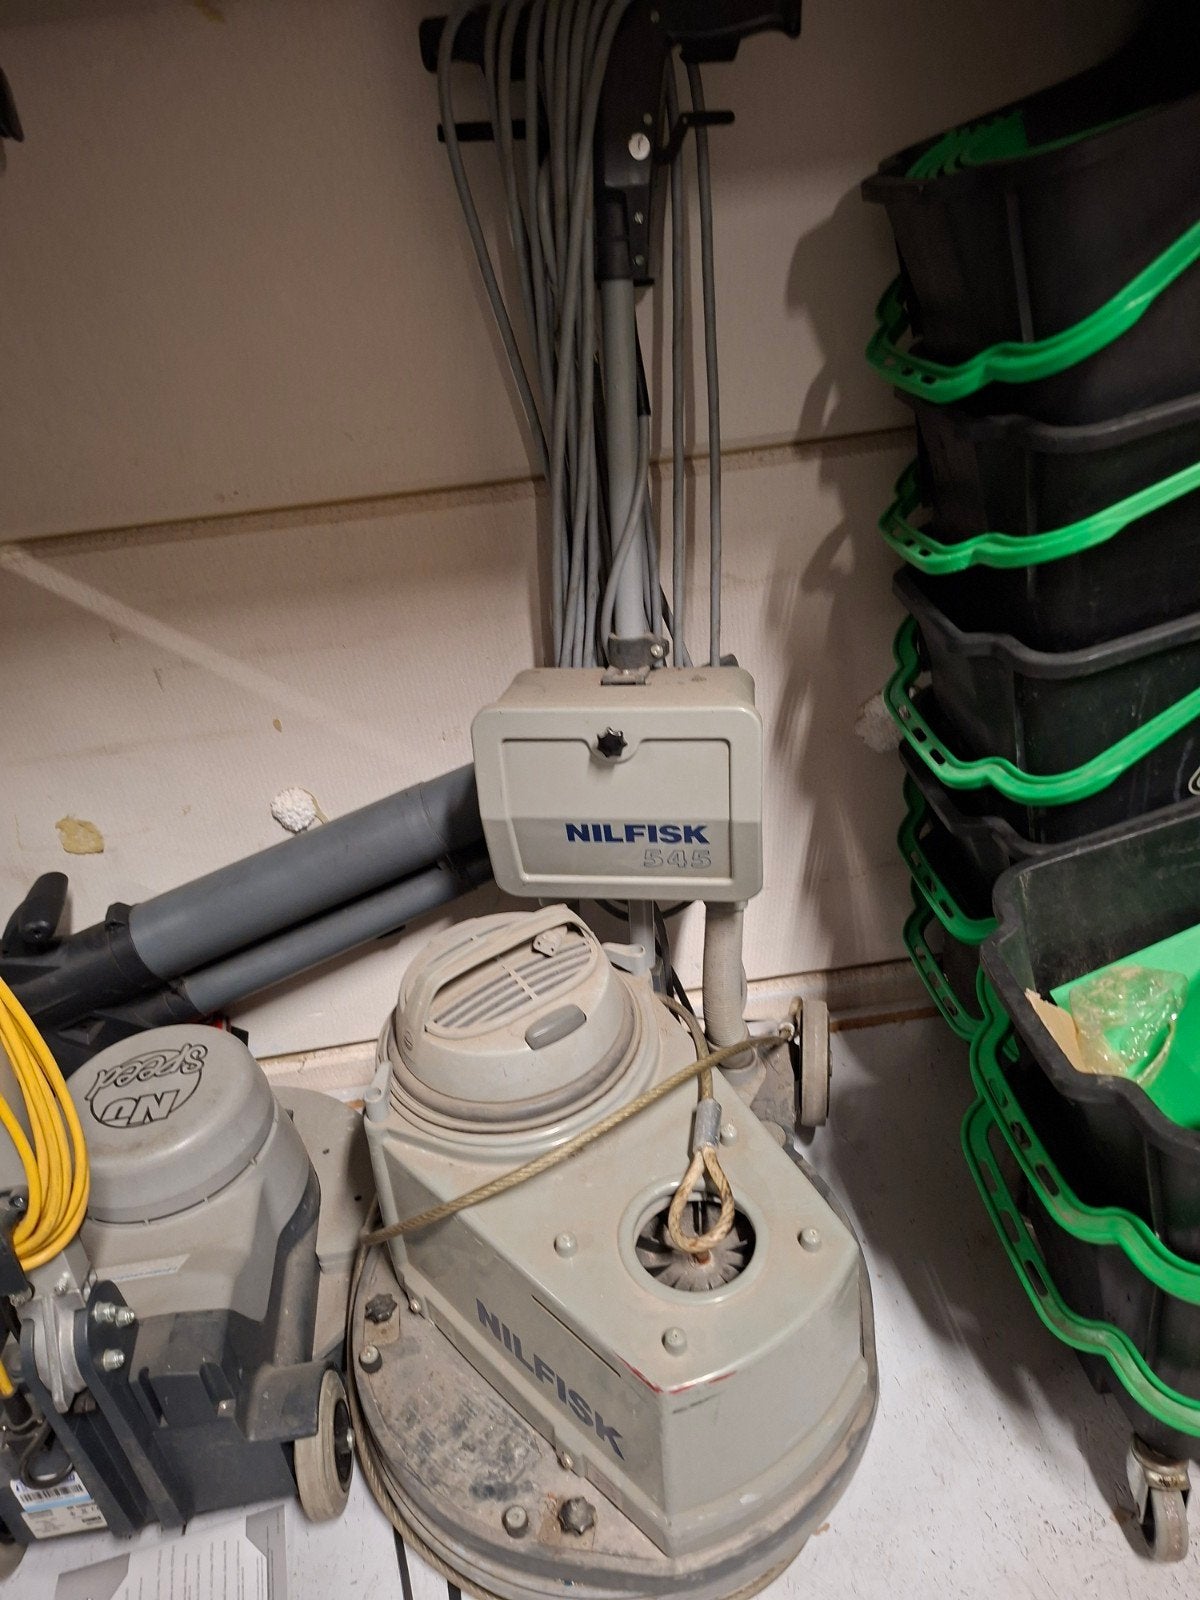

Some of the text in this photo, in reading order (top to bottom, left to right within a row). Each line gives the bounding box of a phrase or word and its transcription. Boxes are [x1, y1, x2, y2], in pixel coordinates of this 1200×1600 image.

[565, 823, 710, 844] NILFISK
[643, 849, 712, 869] 545
[84, 1043, 208, 1101] Speed
[476, 1297, 625, 1461] NILFISK
